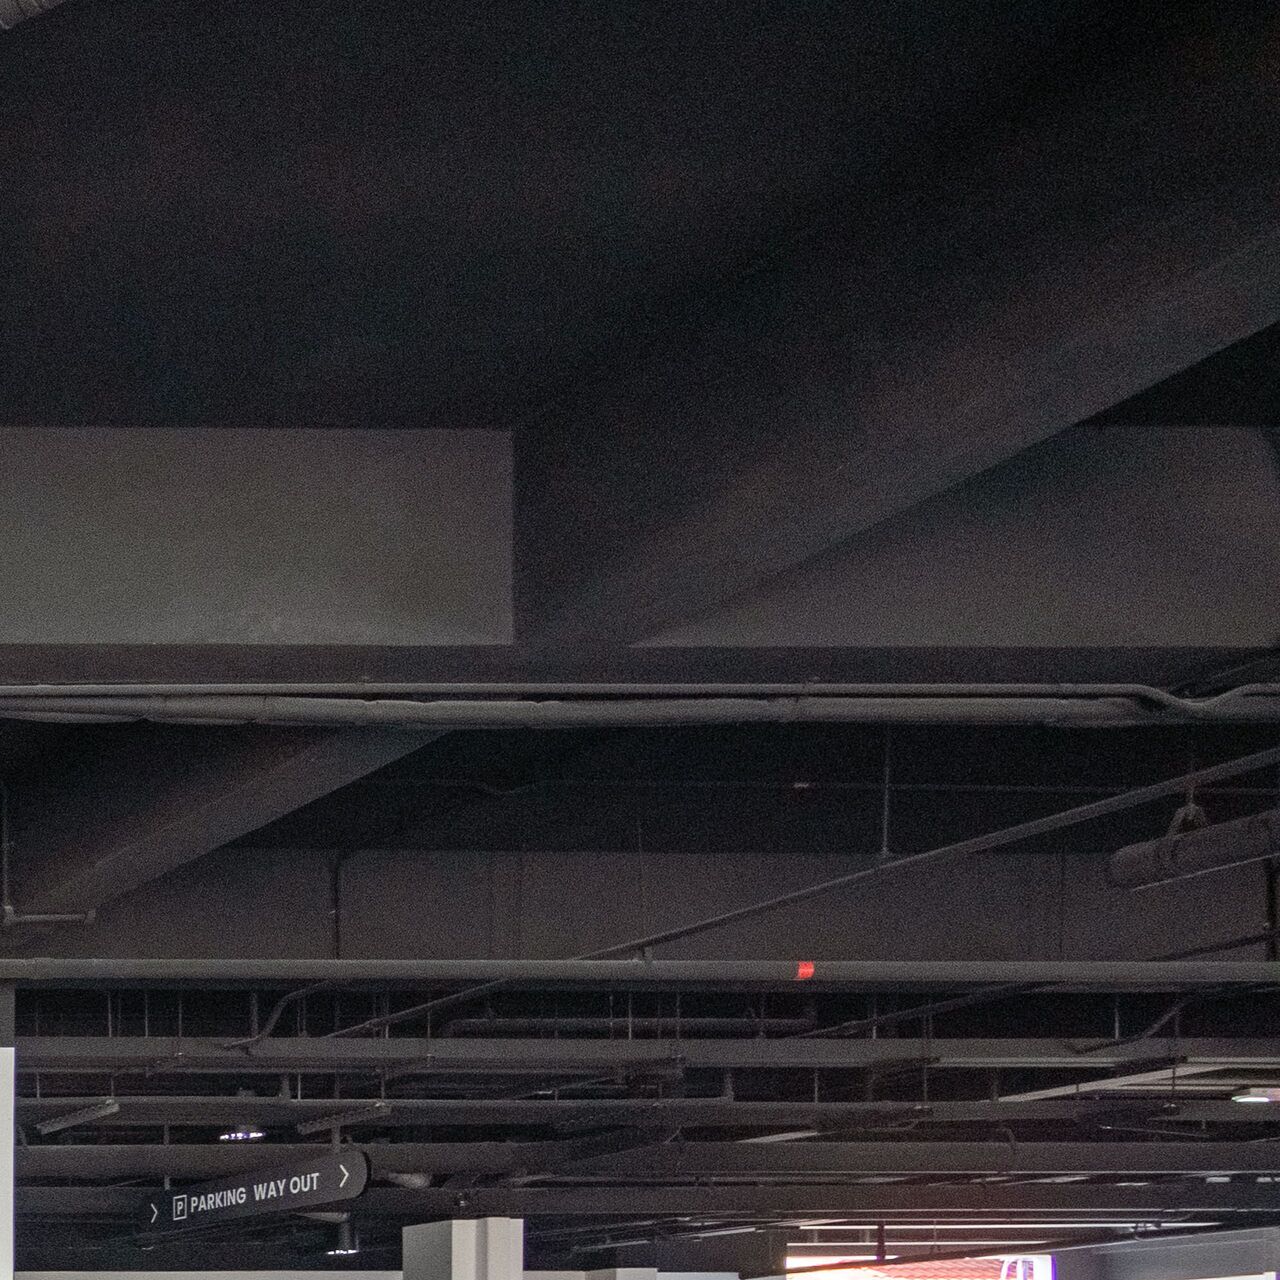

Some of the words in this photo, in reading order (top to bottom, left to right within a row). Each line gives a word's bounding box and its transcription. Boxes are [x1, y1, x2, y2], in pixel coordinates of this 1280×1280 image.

[176, 1201, 185, 1216] P
[190, 1187, 247, 1213] PARKING
[252, 1178, 286, 1202] WAY
[289, 1172, 320, 1194] OUT
